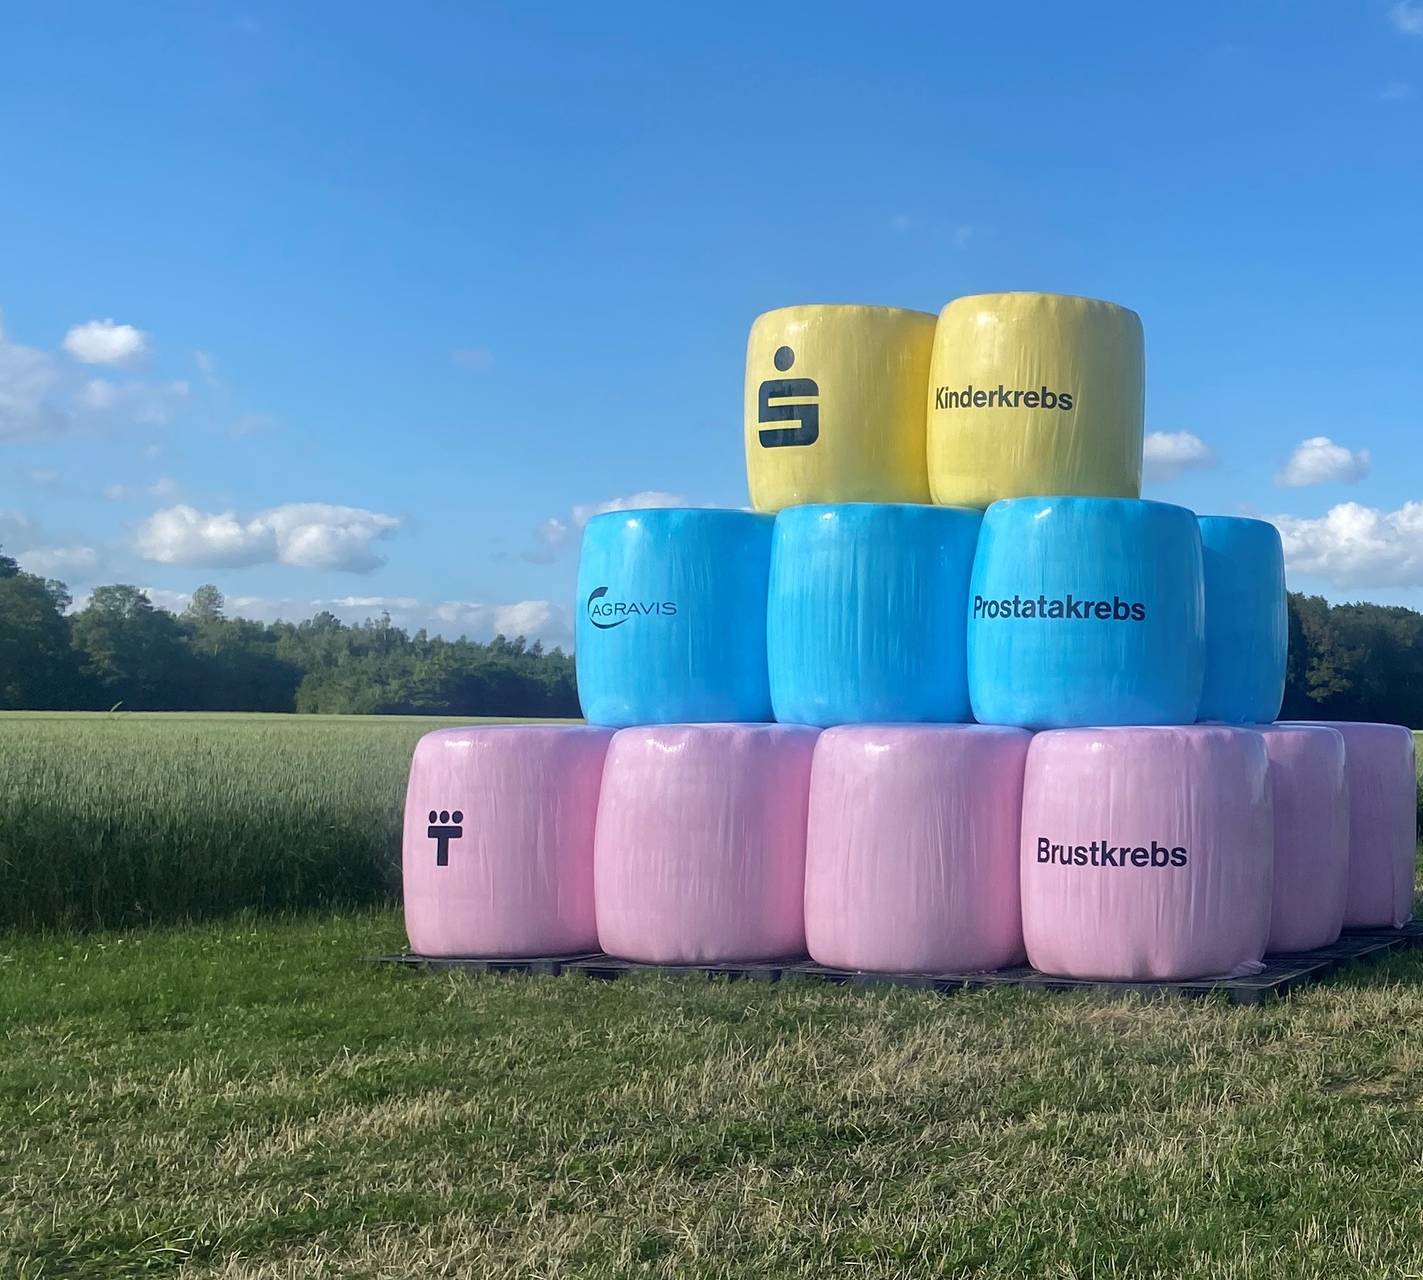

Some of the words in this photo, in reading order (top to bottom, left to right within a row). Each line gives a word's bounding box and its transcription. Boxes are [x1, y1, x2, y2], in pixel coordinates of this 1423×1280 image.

[935, 385, 1073, 411] Kinderkrebs
[592, 602, 677, 617] AGRAVIS
[973, 595, 1146, 621] Prostatakrebs
[1037, 837, 1187, 867] Brustkrebs
